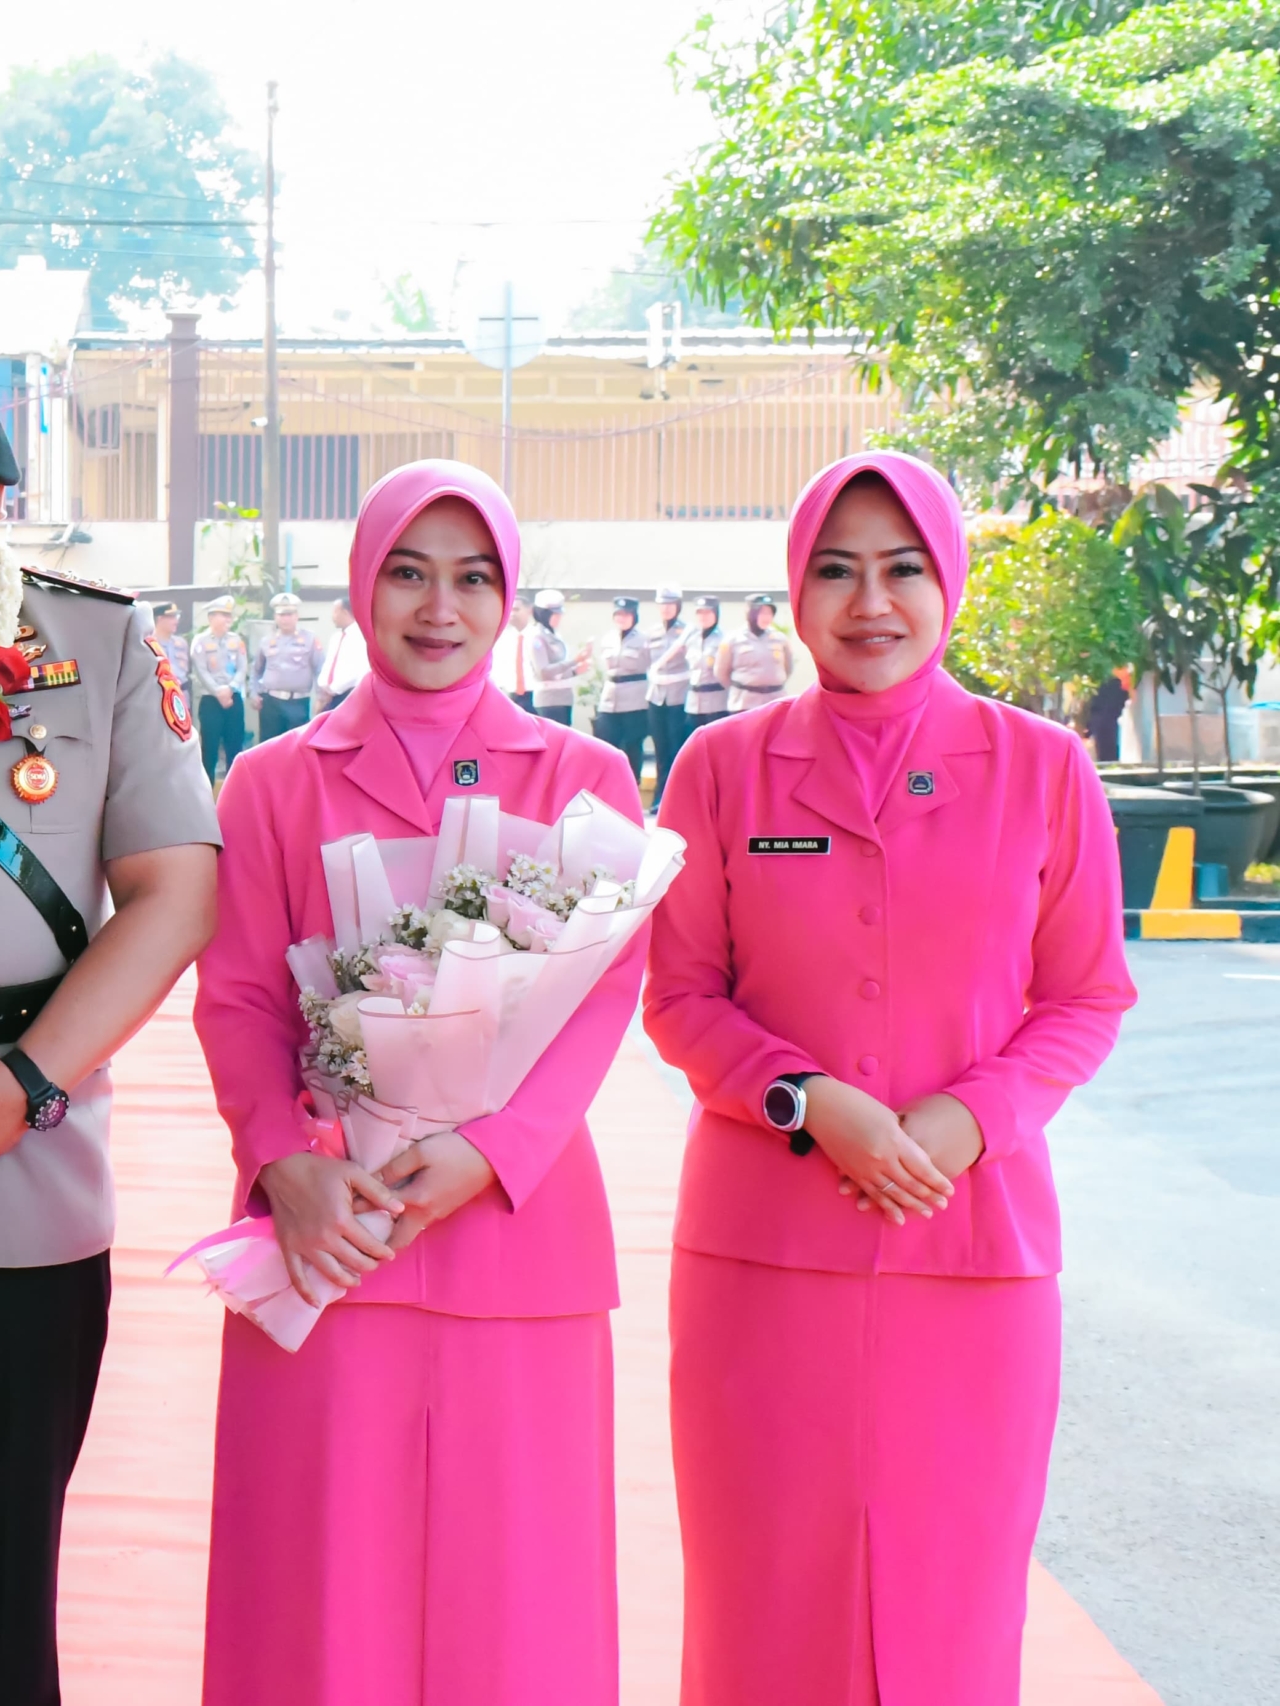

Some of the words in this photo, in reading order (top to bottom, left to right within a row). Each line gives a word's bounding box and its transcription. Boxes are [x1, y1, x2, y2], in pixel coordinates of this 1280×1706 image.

[758, 841, 771, 849] NY.
[773, 841, 789, 849] MIA
[792, 841, 818, 849] IMARA
